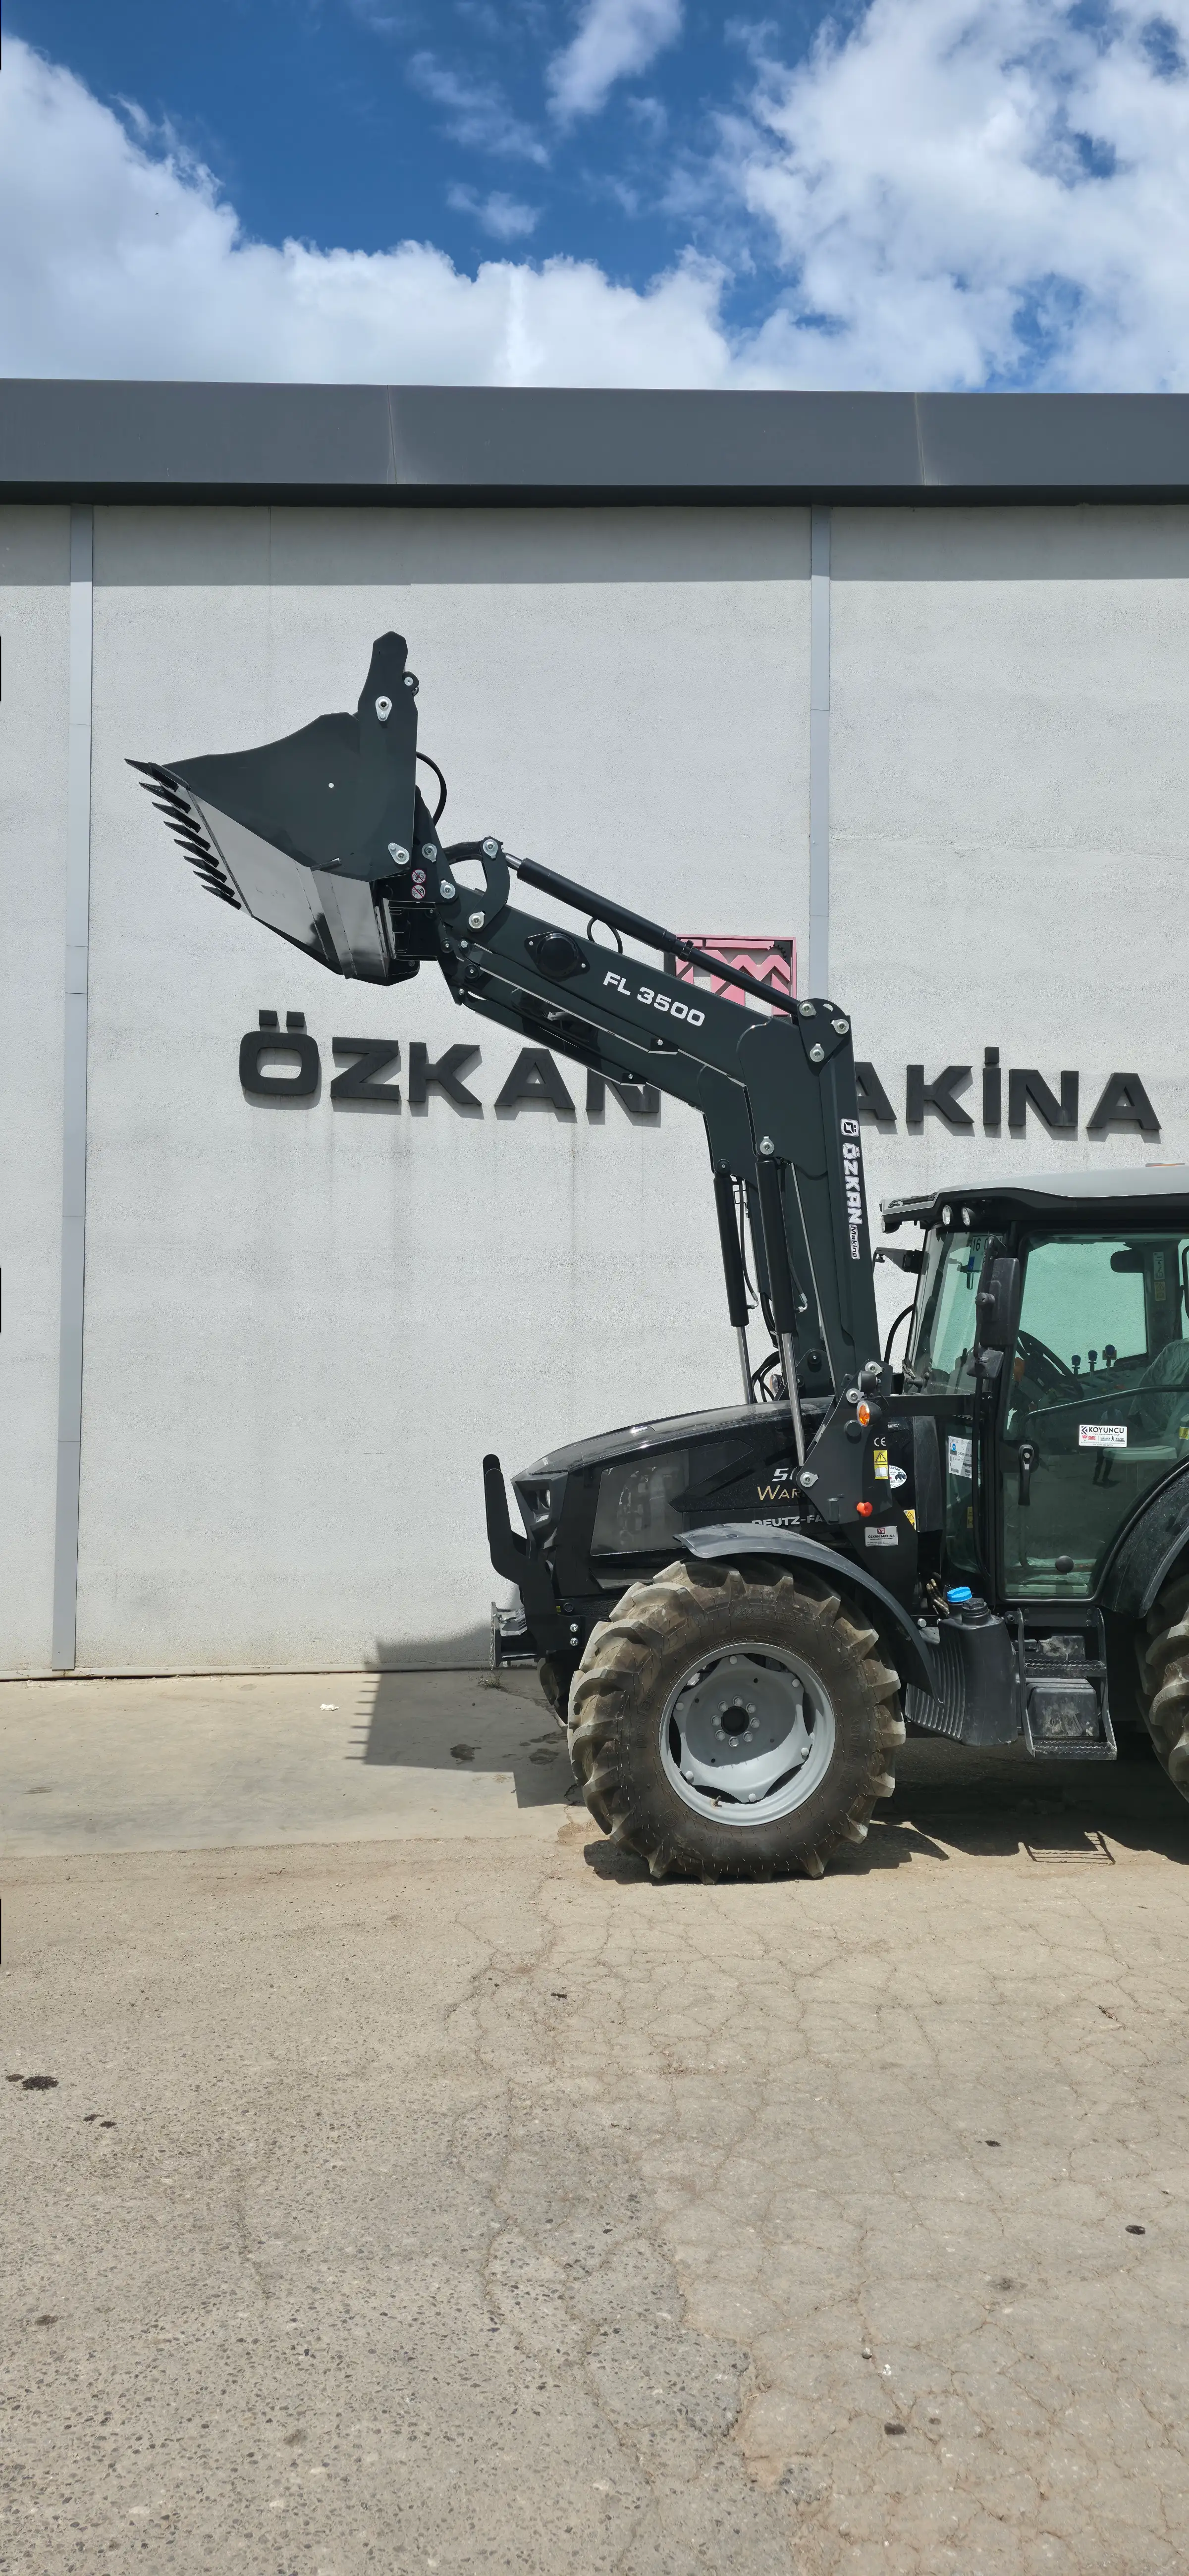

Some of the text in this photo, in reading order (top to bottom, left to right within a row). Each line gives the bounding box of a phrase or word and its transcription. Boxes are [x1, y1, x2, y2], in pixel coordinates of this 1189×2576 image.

[603, 971, 705, 1026] FL 3500
[239, 1009, 1162, 1130] ÖZKAN AKİNA
[842, 1142, 863, 1225] ÖZKAN
[850, 1226, 859, 1258] Makina
[873, 1437, 886, 1447] CE
[757, 1485, 802, 1501] WAR
[752, 1514, 823, 1526] DEUTZ-FA
